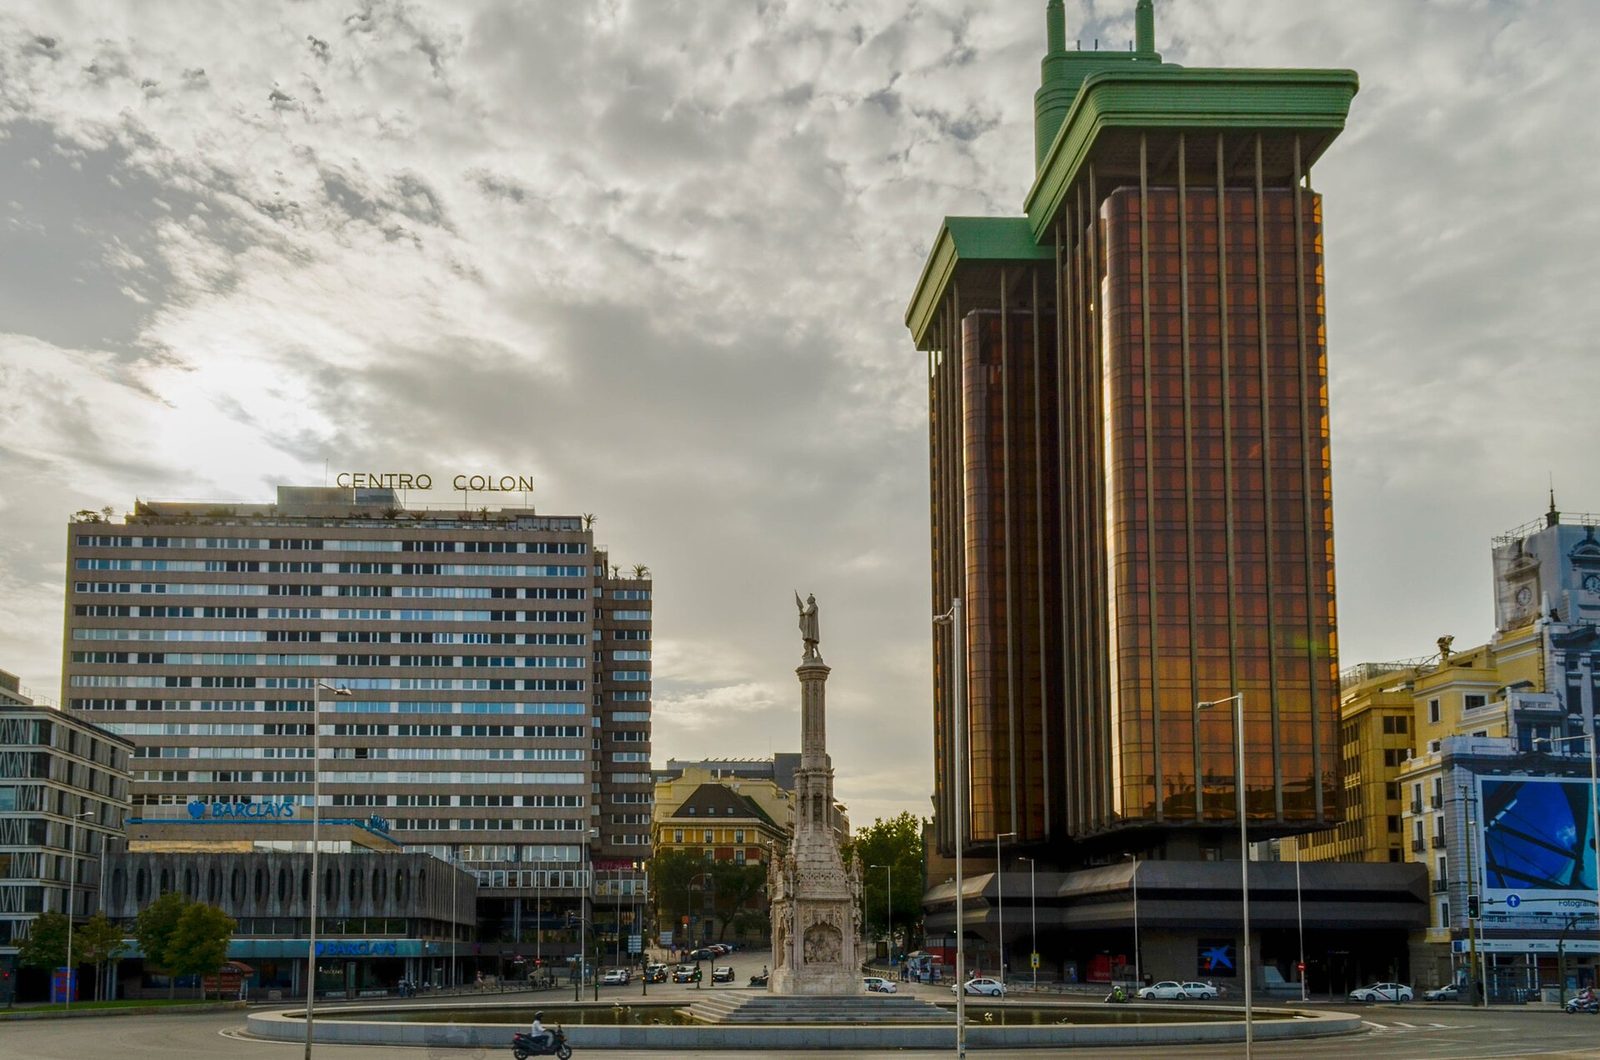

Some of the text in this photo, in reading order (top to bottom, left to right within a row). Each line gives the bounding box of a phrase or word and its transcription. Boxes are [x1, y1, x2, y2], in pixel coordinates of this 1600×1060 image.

[337, 473, 533, 491] CENTRO COLON
[212, 802, 294, 817] BARCLAYS
[328, 943, 395, 955] BARCLAYS
